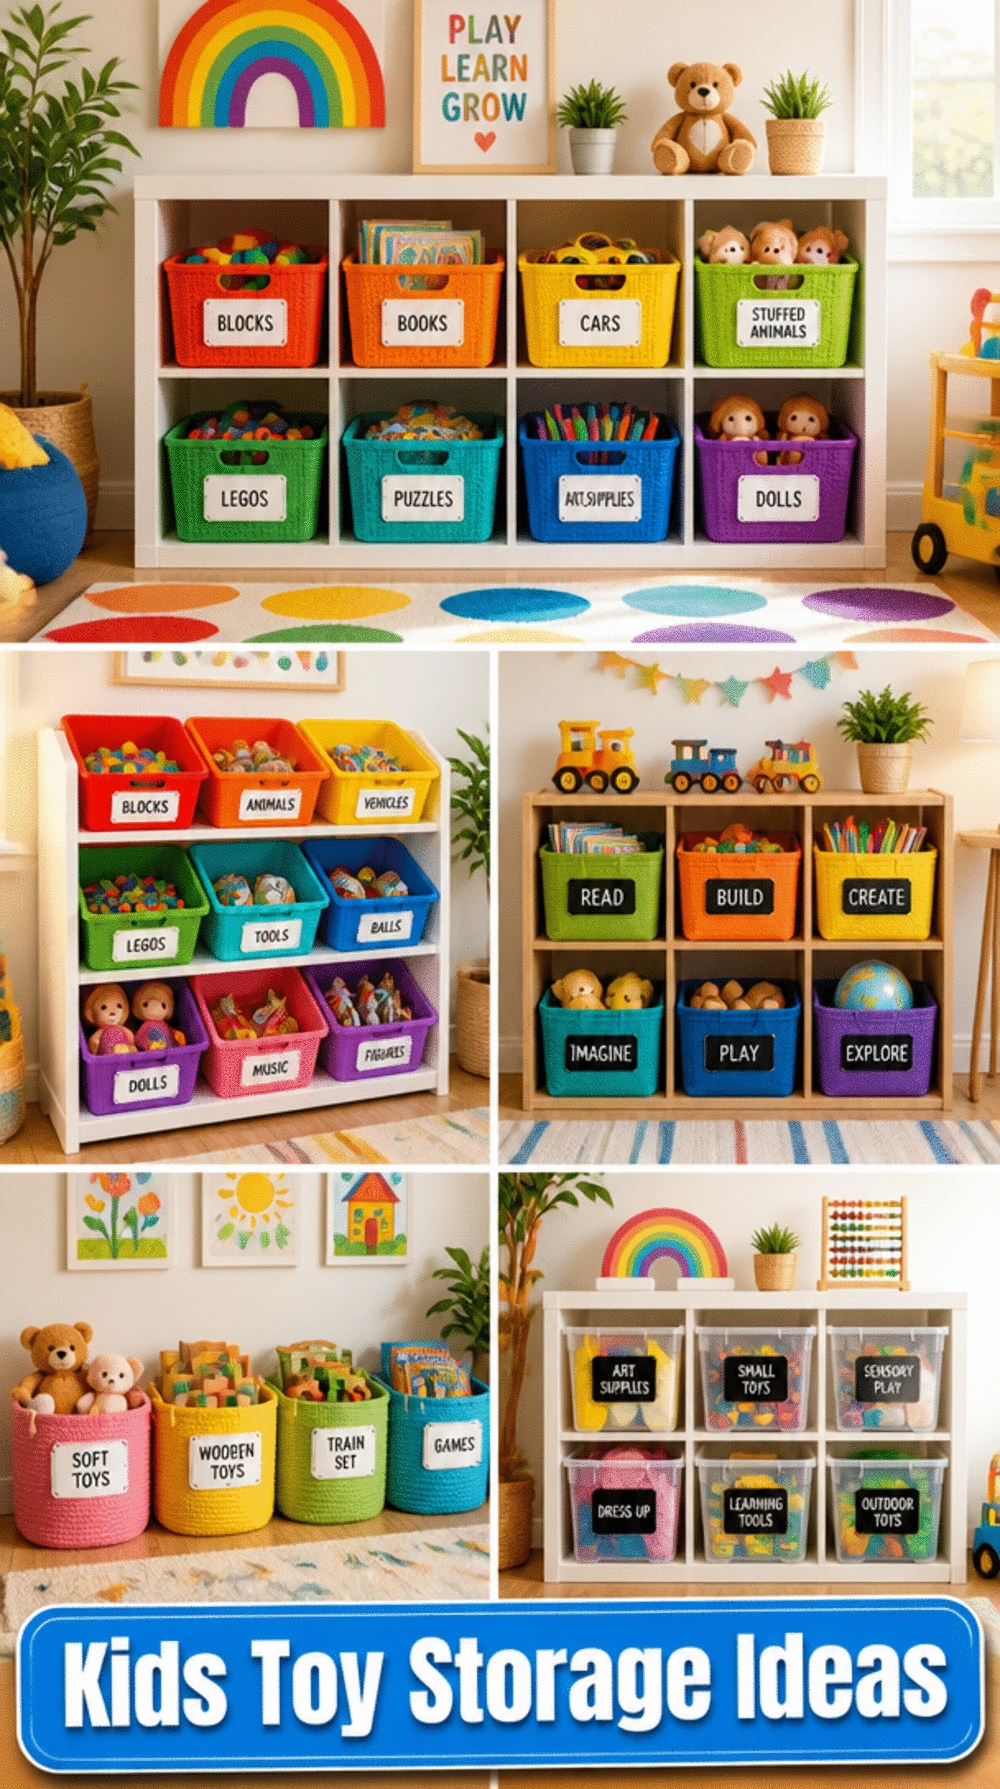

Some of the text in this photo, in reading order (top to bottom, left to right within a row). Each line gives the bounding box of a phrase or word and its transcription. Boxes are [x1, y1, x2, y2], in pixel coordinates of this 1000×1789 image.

[448, 14, 521, 44] PLAY
[441, 53, 528, 83] LEARN
[442, 92, 527, 122] GROW
[753, 307, 805, 321] STUFFED
[218, 314, 273, 332] BLOCKS
[398, 314, 447, 332] BOOKS
[580, 315, 620, 332] CARS
[750, 325, 806, 338] ANIMALS
[221, 490, 268, 507] LEGOS
[394, 490, 453, 507] PUZZLES
[756, 490, 802, 508] DOLLS
[122, 800, 168, 814] BLOCKS
[246, 798, 295, 811] ANIMALS
[365, 796, 408, 809] VEHICLES
[582, 888, 623, 906] READ
[717, 889, 763, 906] BUILD
[849, 888, 904, 906] CREATE
[371, 919, 401, 934] BALLS
[256, 929, 289, 943] TOOLS
[127, 937, 165, 953] LEGOS
[571, 1045, 631, 1061] IMAGINE
[720, 1045, 759, 1061] PLAY
[847, 1044, 908, 1062] EXPLORE
[252, 1060, 288, 1076] MUSIC
[129, 1075, 167, 1093] DOLLS
[613, 1364, 635, 1377] ART
[739, 1365, 774, 1378] SMALL
[863, 1365, 913, 1377] SENSORY
[743, 1381, 770, 1394] TOYS
[875, 1381, 901, 1393] PLAY
[328, 1436, 364, 1452] TRAIN
[434, 1437, 474, 1453] GAMES
[72, 1450, 108, 1468] SOFT
[335, 1454, 356, 1470] SET
[72, 1471, 110, 1488] TOYS
[211, 1464, 245, 1479] TOYS
[598, 1505, 650, 1518] DRESS UP
[862, 1497, 913, 1510] OUTDOOR
[739, 1513, 772, 1527] TOOLS
[875, 1513, 901, 1526] TOYS
